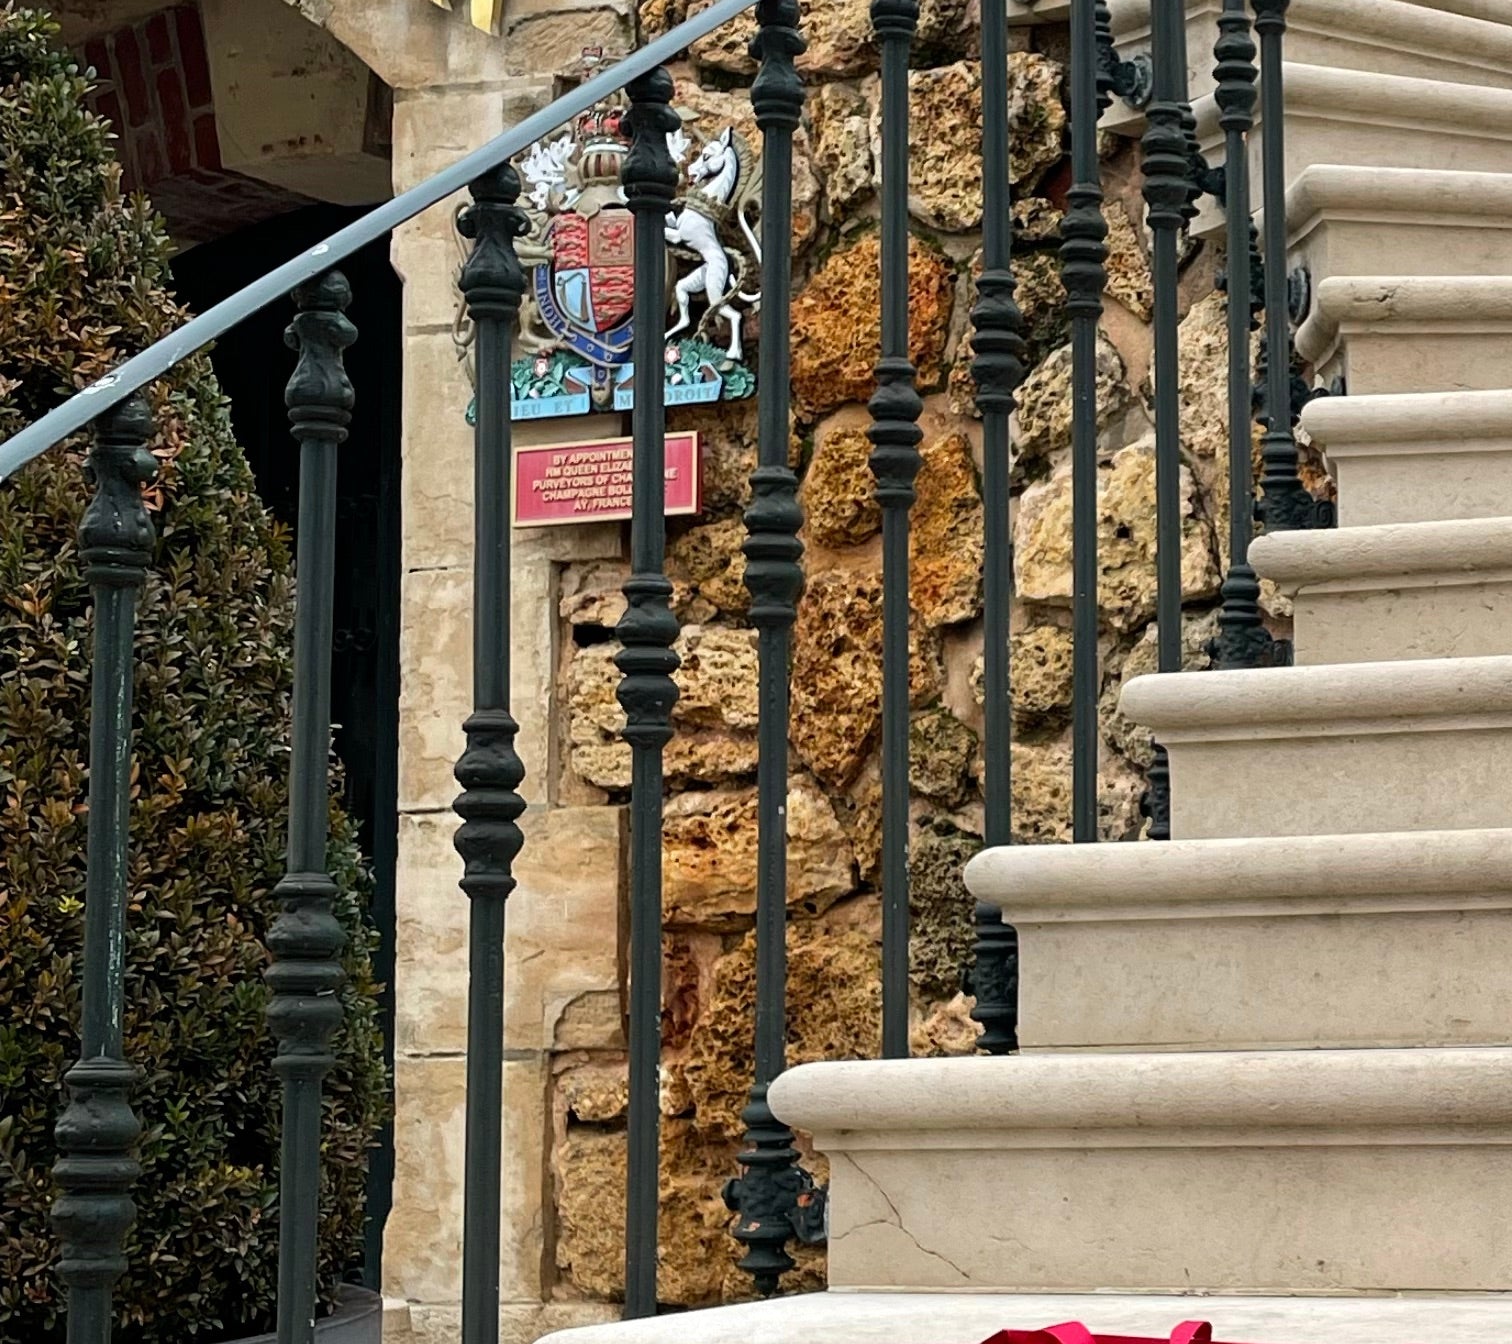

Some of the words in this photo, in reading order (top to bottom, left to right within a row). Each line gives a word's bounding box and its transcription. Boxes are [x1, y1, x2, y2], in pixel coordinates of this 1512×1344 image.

[513, 402, 541, 417] IEU
[553, 453, 568, 466] BY
[570, 449, 633, 464] APPOINTMEN
[563, 464, 598, 476] QUEEN
[533, 475, 594, 490] PURVEYORS
[542, 487, 606, 502] CHAMPAGNE
